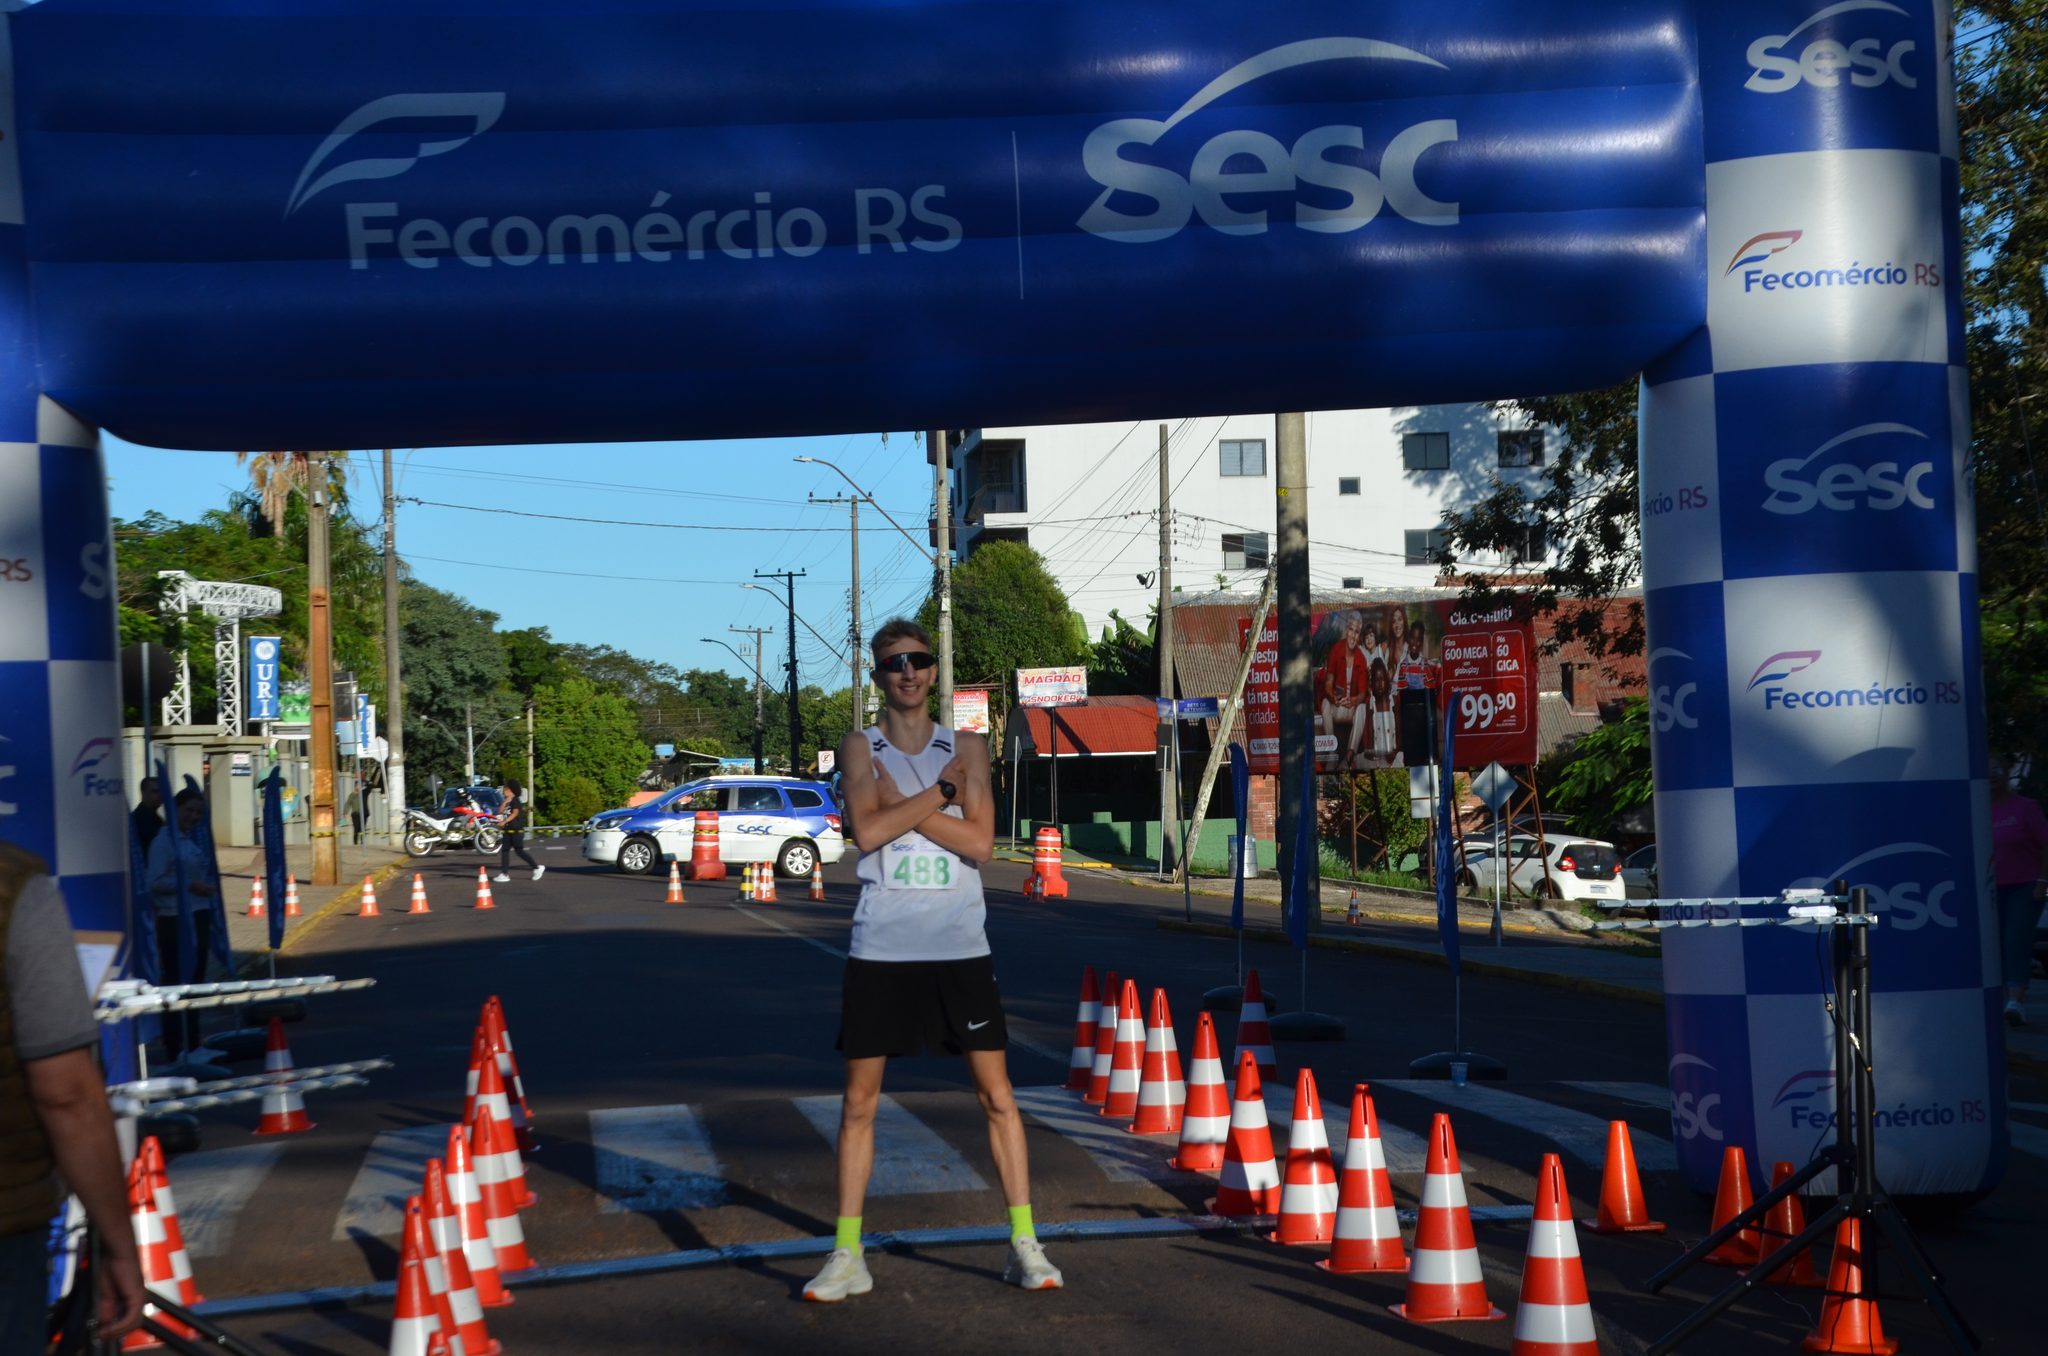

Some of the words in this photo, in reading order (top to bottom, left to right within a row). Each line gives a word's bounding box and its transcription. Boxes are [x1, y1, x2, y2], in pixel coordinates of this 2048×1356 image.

[1075, 117, 1460, 243] Sesc
[345, 190, 827, 270] Fecomércio
[854, 184, 963, 254] RS
[1744, 262, 1907, 292] Fecomércio
[1914, 264, 1941, 287] RS
[1678, 485, 1708, 511] RS
[1445, 648, 1461, 660] 600
[1463, 646, 1488, 659] MEGA
[1496, 645, 1509, 657] 60
[1496, 659, 1520, 671] GIGA
[1461, 692, 1516, 729] 99,90
[1649, 682, 1698, 733] sc
[1765, 683, 1928, 710] Fecomércio
[1935, 682, 1960, 704] RS
